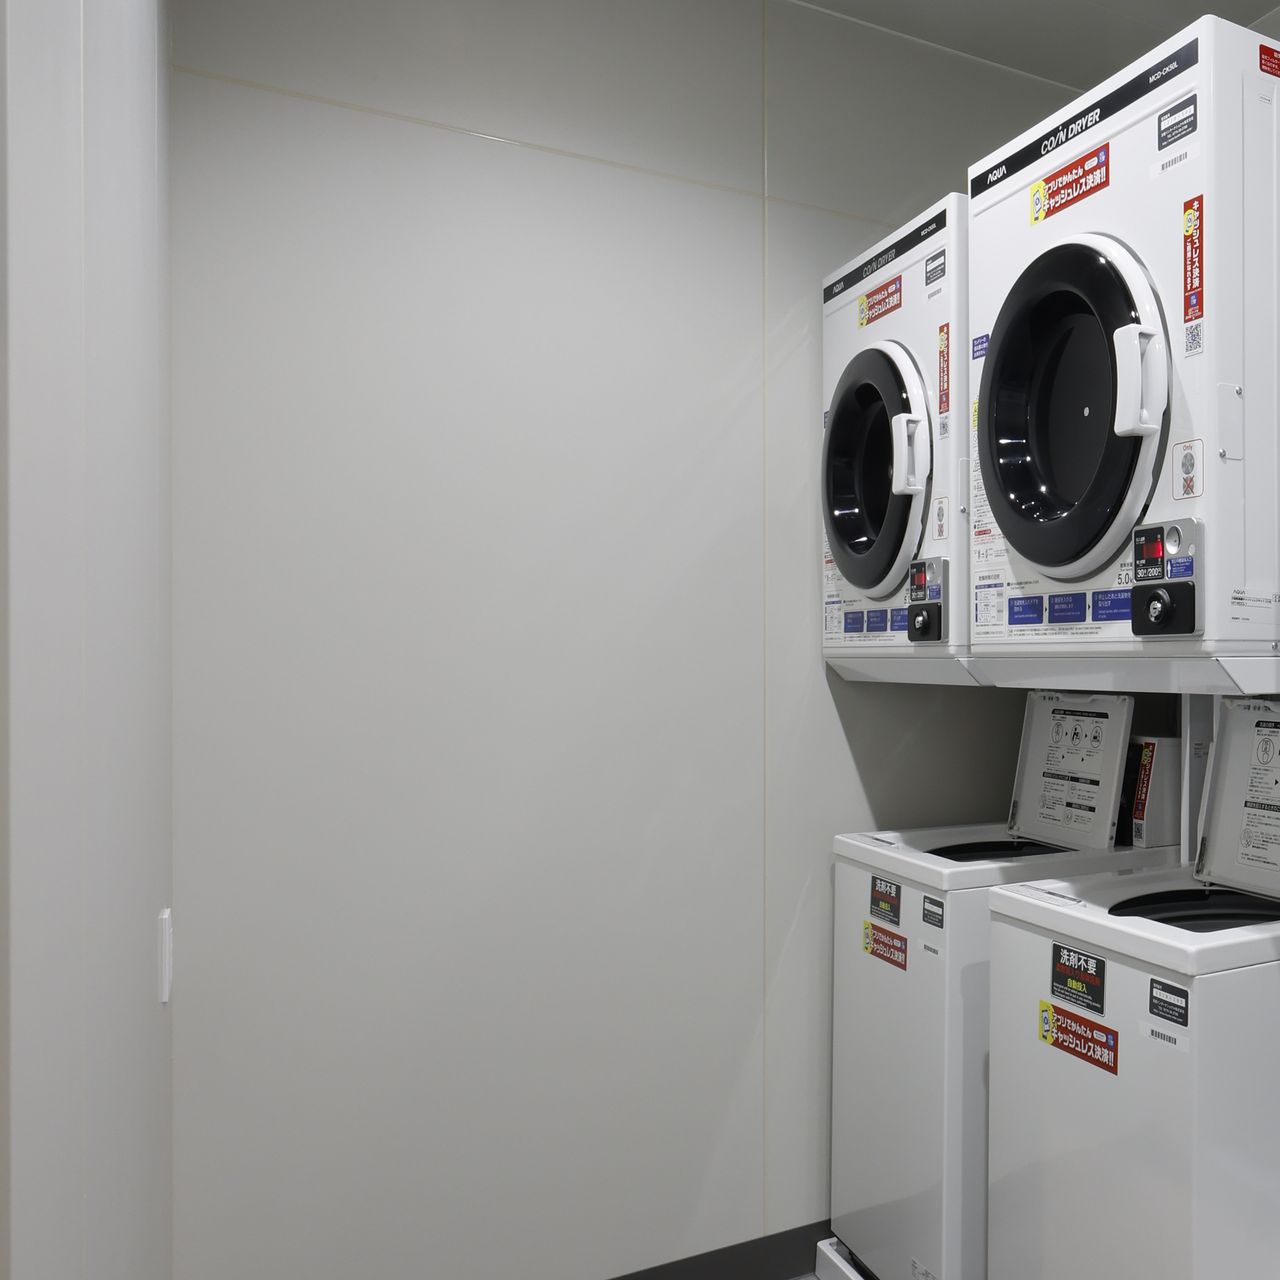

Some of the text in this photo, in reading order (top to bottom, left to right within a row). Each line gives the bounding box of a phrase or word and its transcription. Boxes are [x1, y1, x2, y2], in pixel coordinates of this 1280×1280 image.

[1041, 107, 1100, 155] COIN DRYER
[987, 164, 1007, 184] AQUA
[1060, 948, 1097, 975] 洗剤不要
